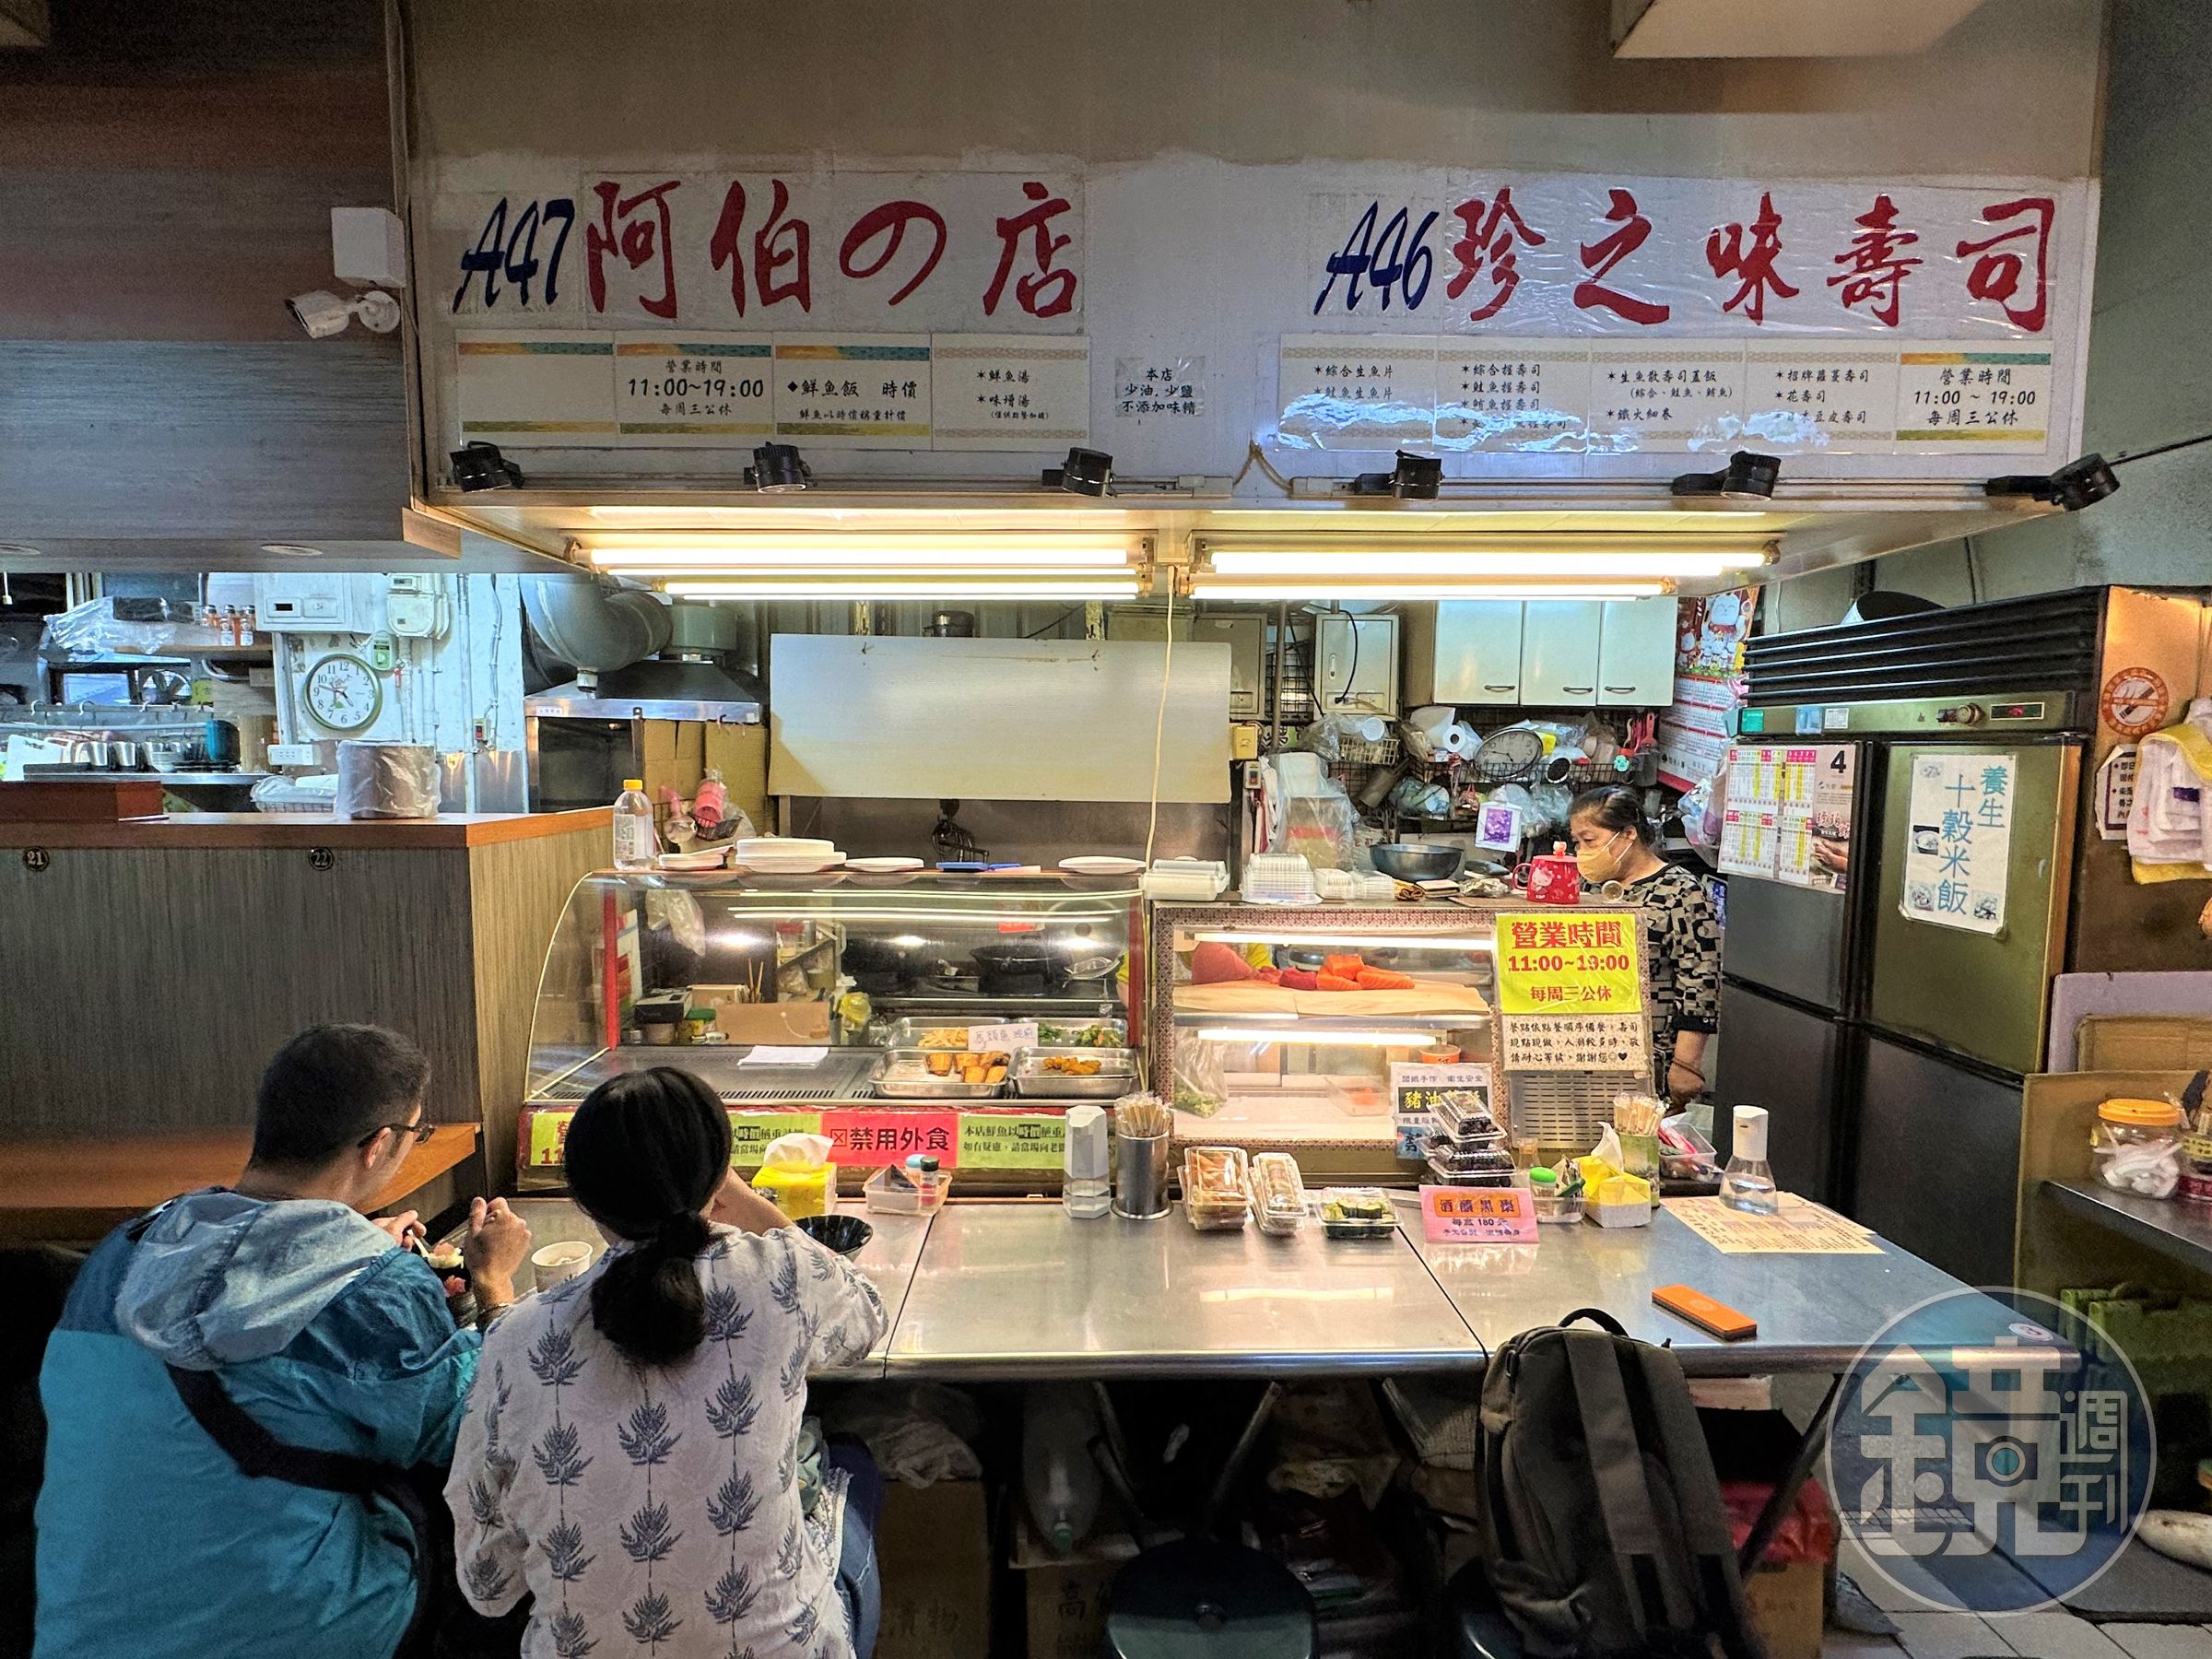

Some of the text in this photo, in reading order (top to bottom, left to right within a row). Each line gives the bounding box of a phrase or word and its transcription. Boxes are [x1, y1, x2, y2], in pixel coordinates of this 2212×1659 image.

[453, 181, 1078, 320] A47 阿伯の店
[1313, 185, 2054, 332] A46 珍之味壽司
[665, 359, 724, 373] 營業時間
[1146, 367, 1172, 382] 本店
[1325, 365, 1394, 379] 綜合生魚片
[1473, 363, 1541, 377] 綜合握壽司
[987, 369, 1030, 383] 鮮魚湯
[1939, 368, 2013, 386] 營業時間
[628, 378, 764, 398] 11:00~19:00
[801, 381, 918, 398] 鮮魚飯 時價
[1786, 389, 1827, 403] 花壽司
[1913, 389, 1961, 406] 11:00
[1990, 389, 2037, 406] 19:00
[660, 403, 732, 416] 每周三公休
[1122, 400, 1196, 415] 不添加味精
[1925, 408, 2019, 427] 每周三公休
[1830, 750, 1847, 773] 4
[1977, 765, 2008, 829] 養生
[1936, 773, 1976, 915] 十穀米飯
[26, 852, 43, 866] 21
[1512, 921, 1622, 947] 營業時間
[1530, 985, 1612, 1002] 每周三公休
[850, 1126, 950, 1151] 禁用外食
[965, 1124, 1065, 1140] 本店鮮魚以時價稱重
[1477, 1218, 1495, 1226] 180
